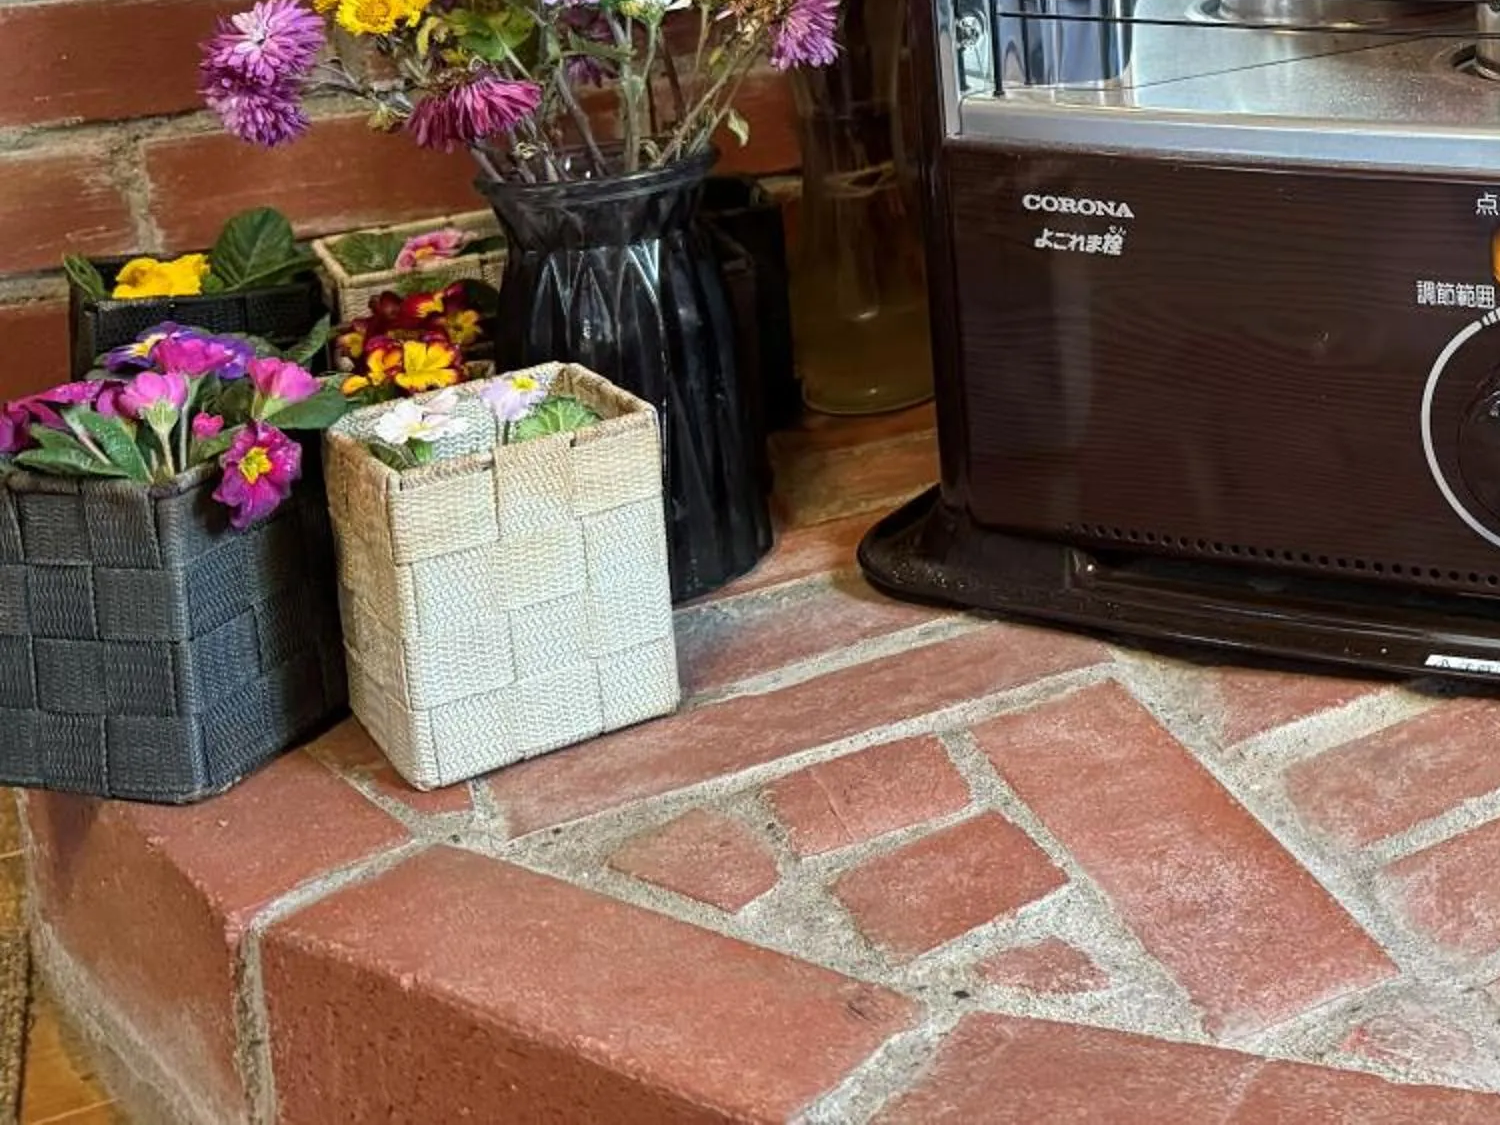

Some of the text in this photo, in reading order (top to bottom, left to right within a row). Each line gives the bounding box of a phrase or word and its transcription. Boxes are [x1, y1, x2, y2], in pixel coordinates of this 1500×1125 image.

[1022, 194, 1135, 219] CORONA
[1416, 280, 1495, 308] 調節範囲
